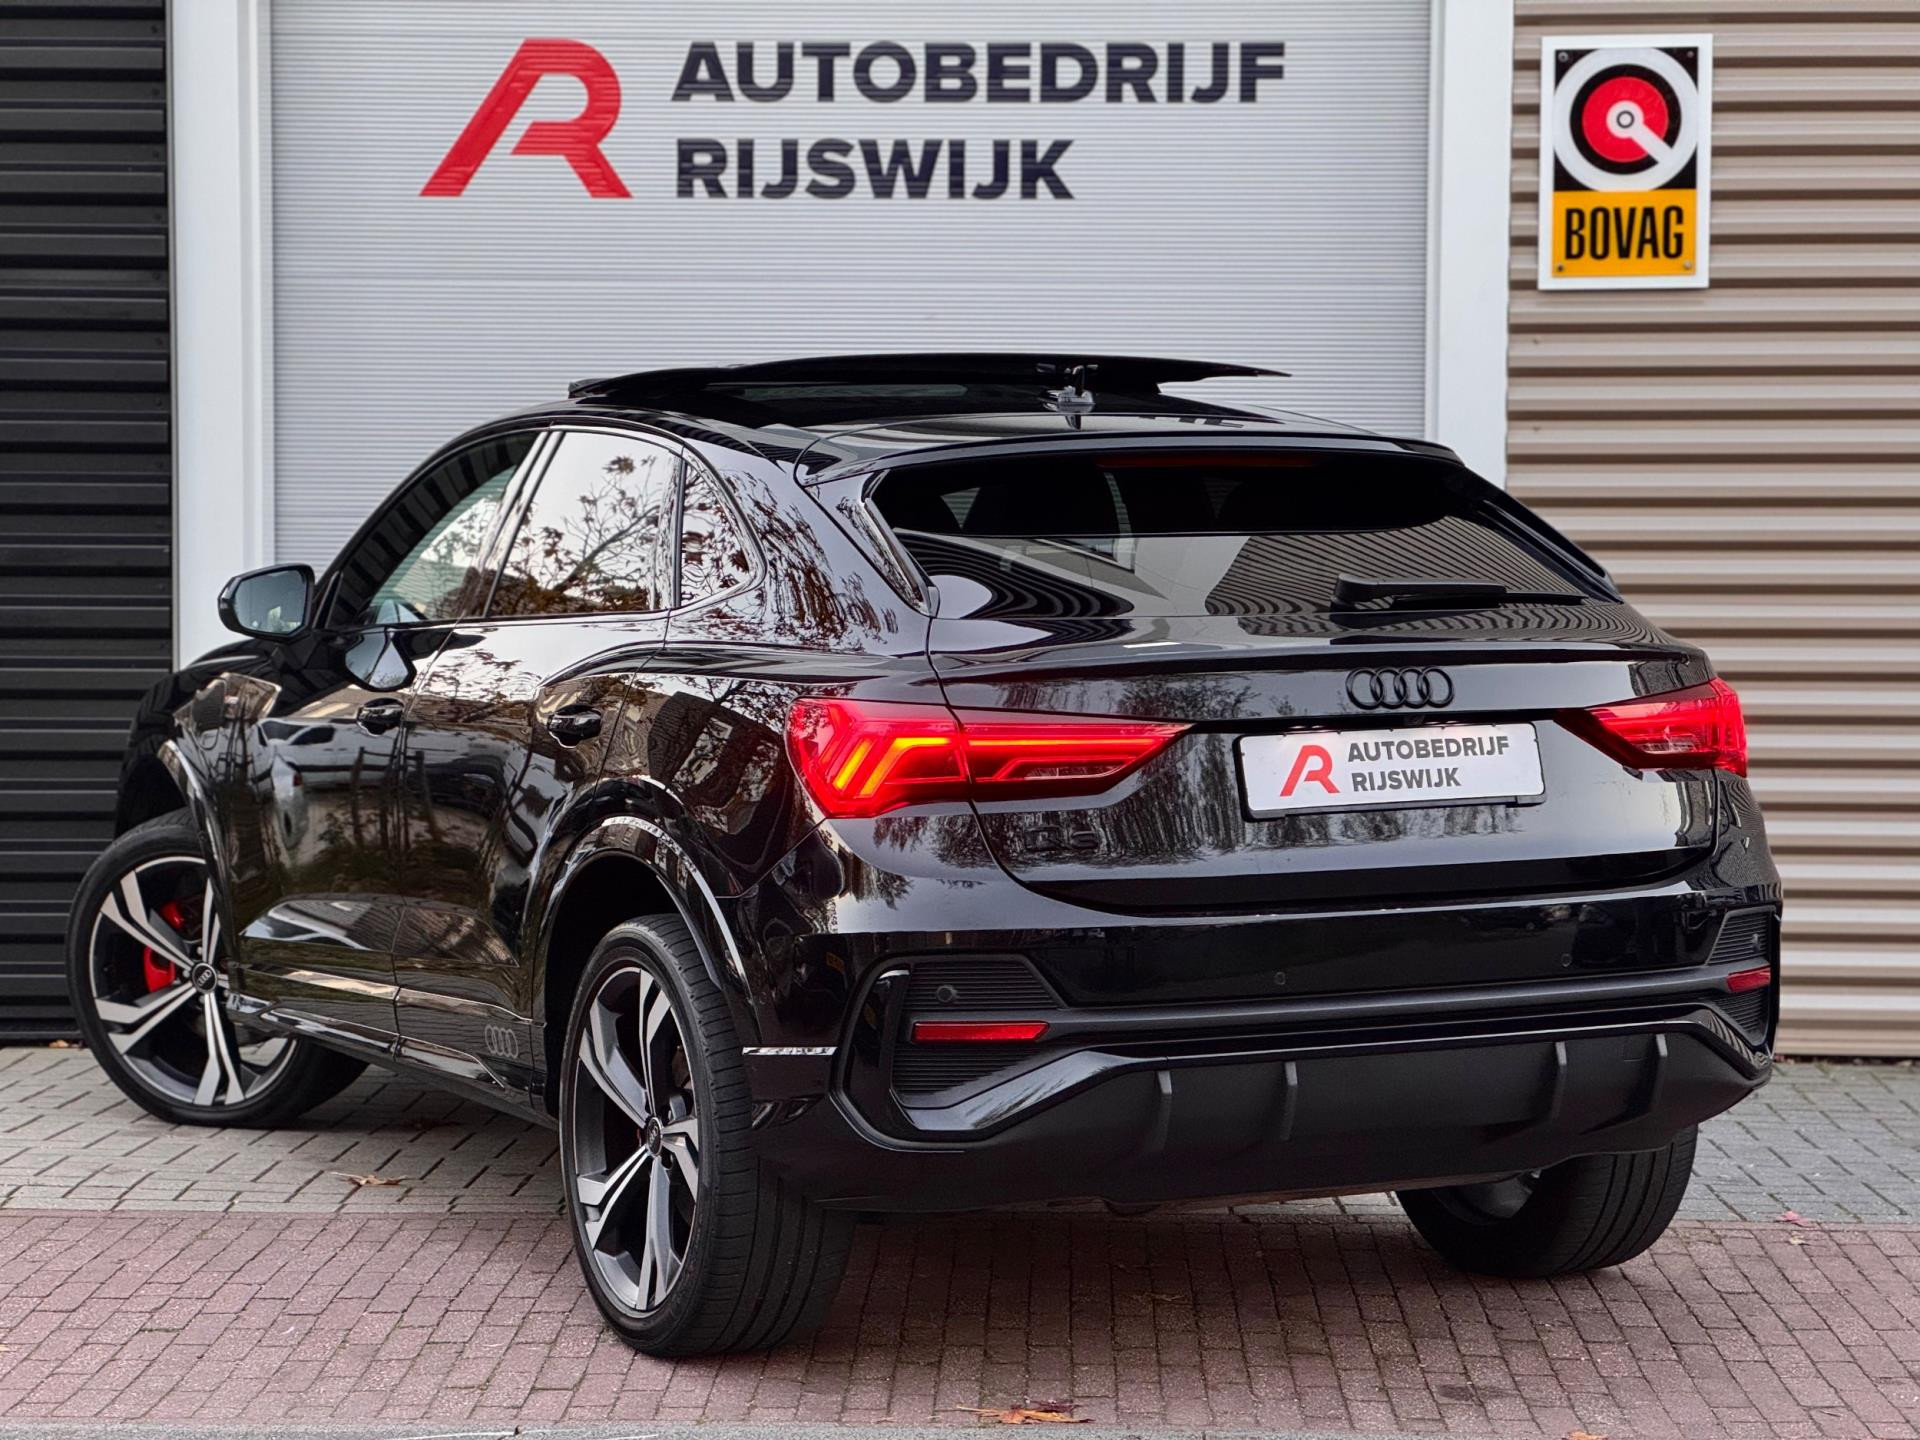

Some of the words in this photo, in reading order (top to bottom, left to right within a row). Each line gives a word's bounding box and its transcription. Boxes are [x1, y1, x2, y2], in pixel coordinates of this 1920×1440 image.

[672, 42, 1285, 103] AUTOBEDRIJF
[677, 138, 1075, 200] RIJSWIJK
[1564, 205, 1684, 261] BOVAG
[1347, 735, 1509, 763] AUTOBEDRIJF
[1351, 767, 1462, 793] RIJSWIJK
